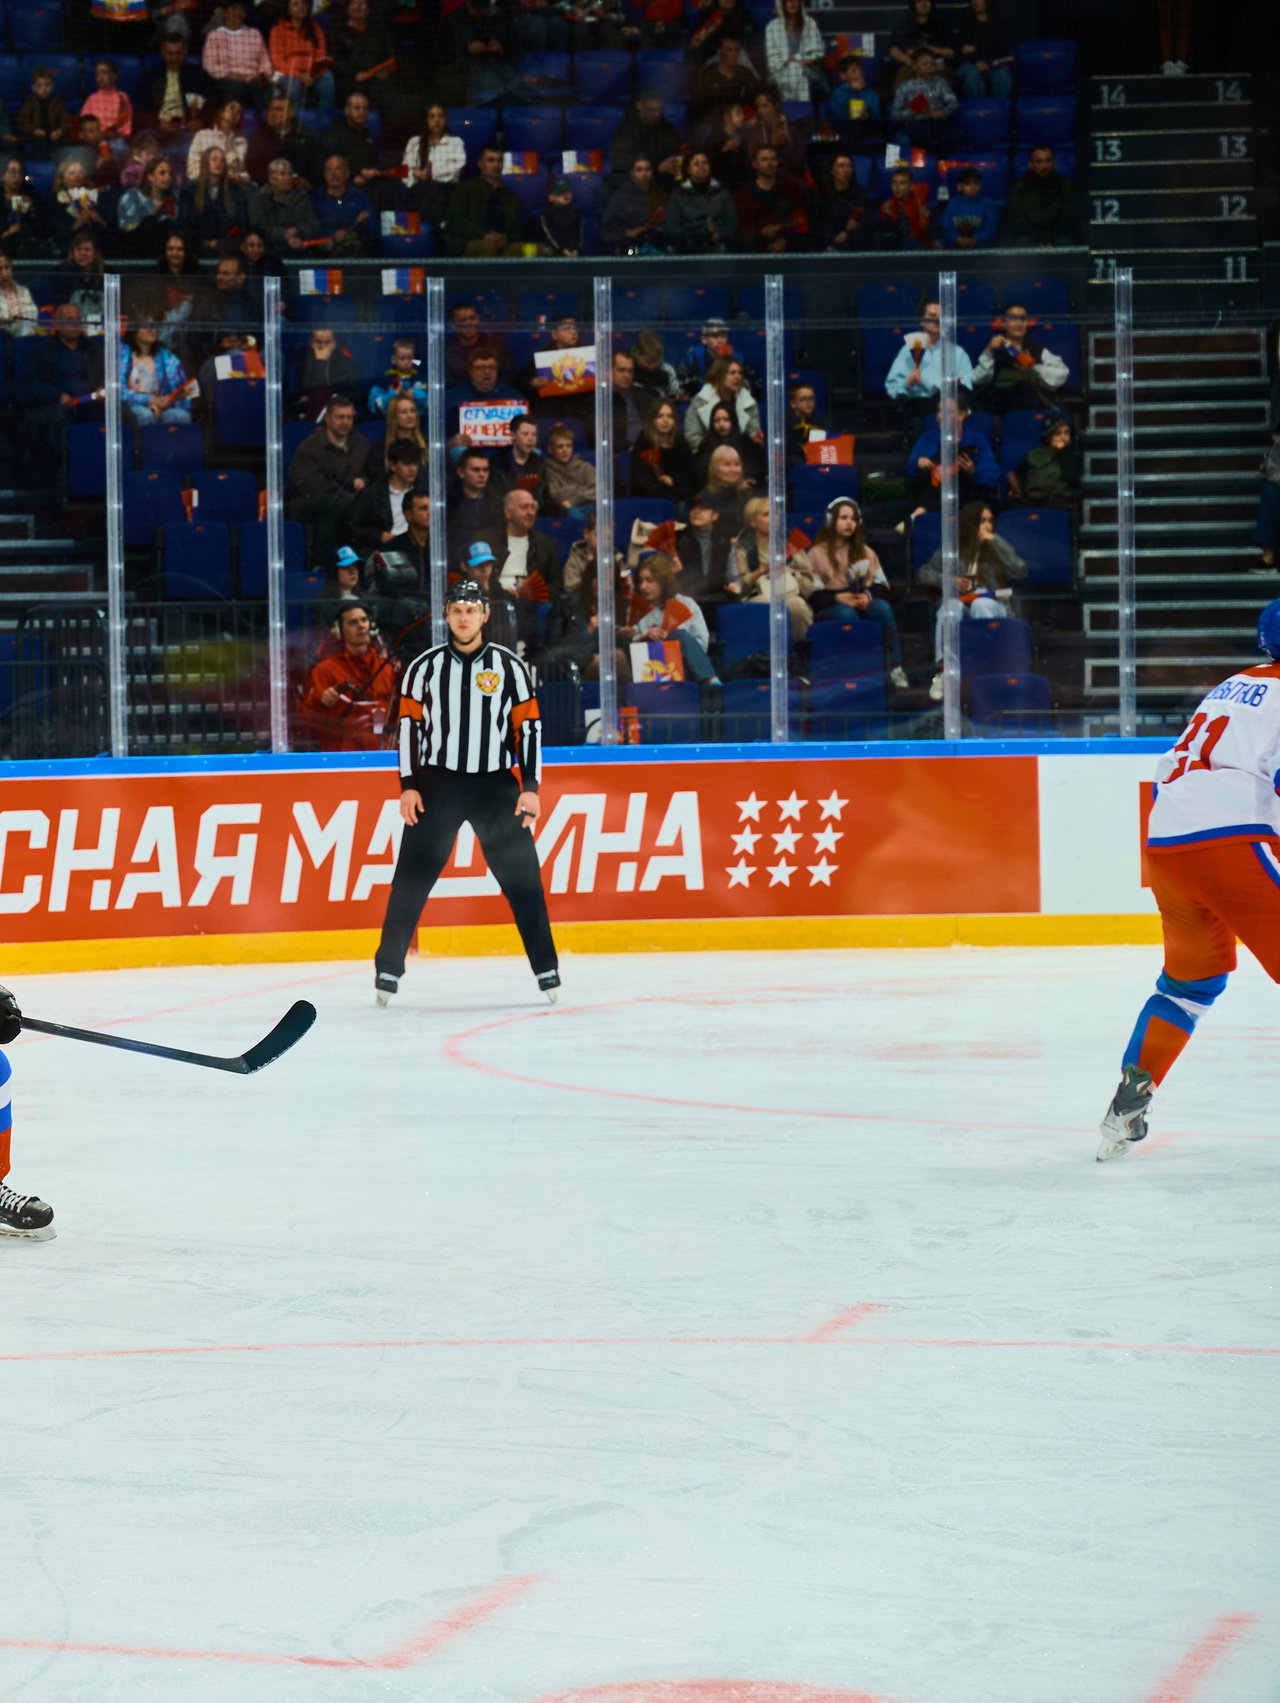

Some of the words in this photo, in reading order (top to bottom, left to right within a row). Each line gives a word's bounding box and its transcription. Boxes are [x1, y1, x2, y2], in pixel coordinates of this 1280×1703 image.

[1099, 83, 1127, 107] 14
[1215, 80, 1242, 103] 14
[1094, 138, 1123, 161] 13
[1219, 135, 1248, 158] 13
[1092, 198, 1120, 222] 12
[1220, 195, 1248, 218] 12
[1093, 257, 1117, 281] 11
[1224, 256, 1247, 281] 11
